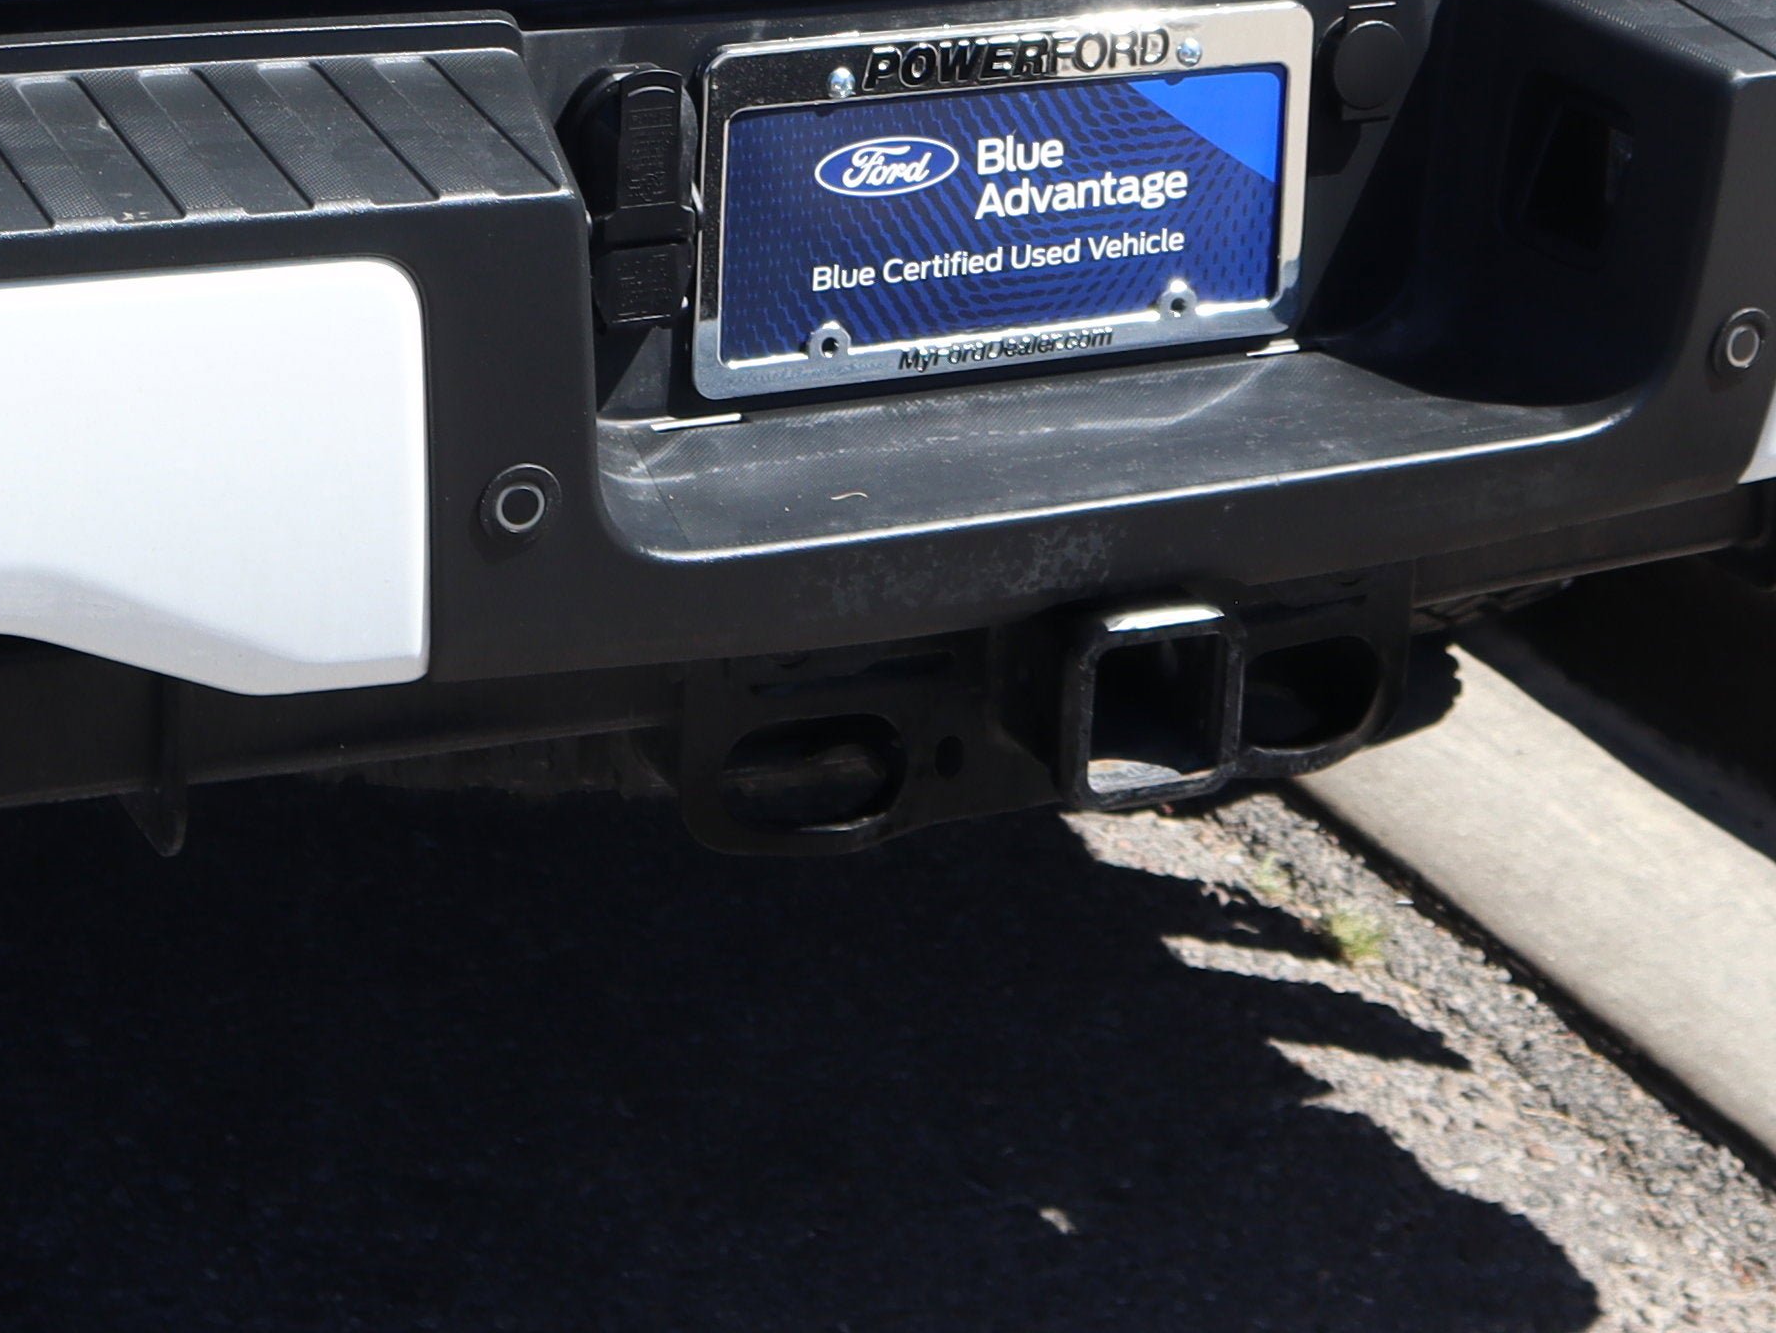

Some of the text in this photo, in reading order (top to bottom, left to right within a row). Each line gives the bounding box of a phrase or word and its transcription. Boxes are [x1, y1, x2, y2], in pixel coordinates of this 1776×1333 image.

[841, 144, 932, 189] Ford
[976, 134, 1065, 175] Blue
[974, 170, 1188, 220] Advantage
[811, 227, 1185, 292] Blue Certified Used Vehicle
